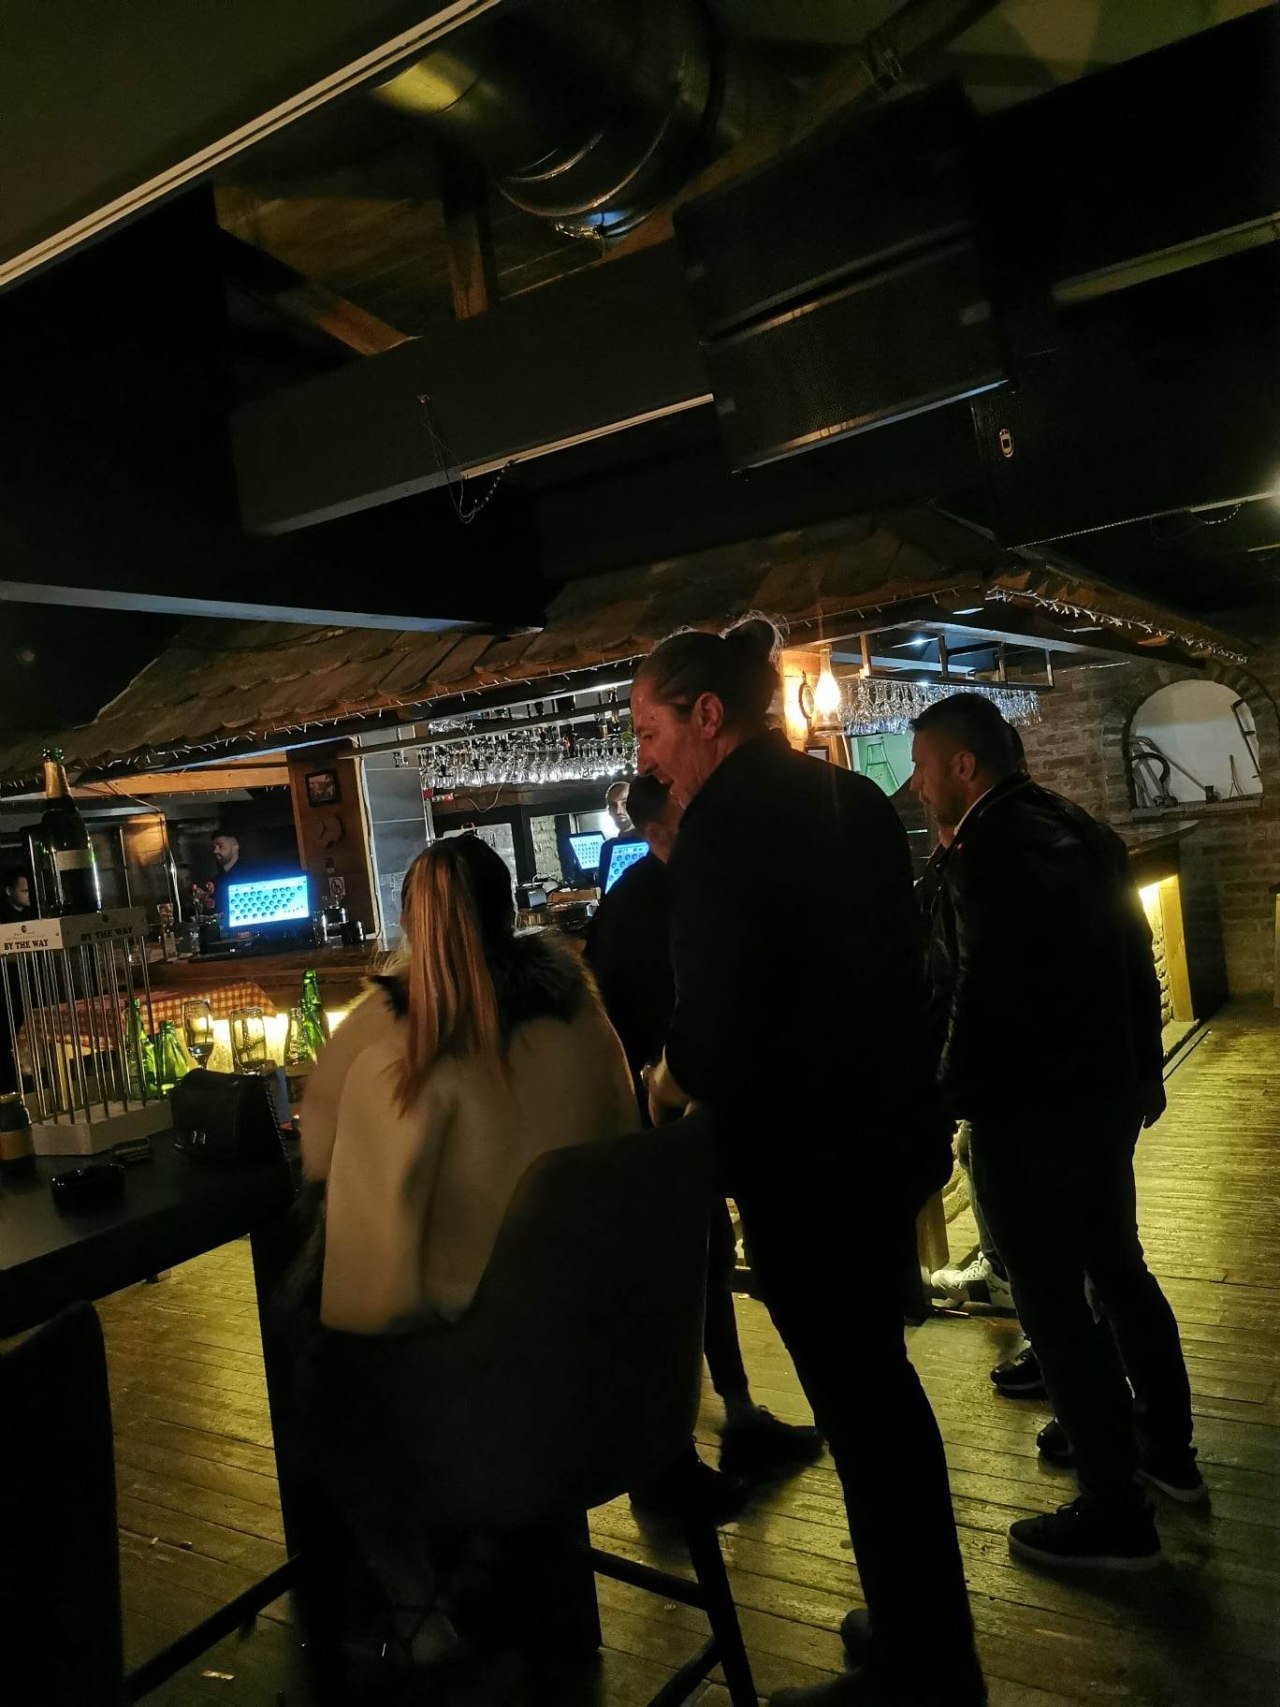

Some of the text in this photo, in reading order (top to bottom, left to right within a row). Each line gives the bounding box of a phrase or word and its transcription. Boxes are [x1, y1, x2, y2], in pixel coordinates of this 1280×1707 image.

[81, 926, 133, 942] BY THE WAY
[4, 939, 49, 951] BY THE WAY
